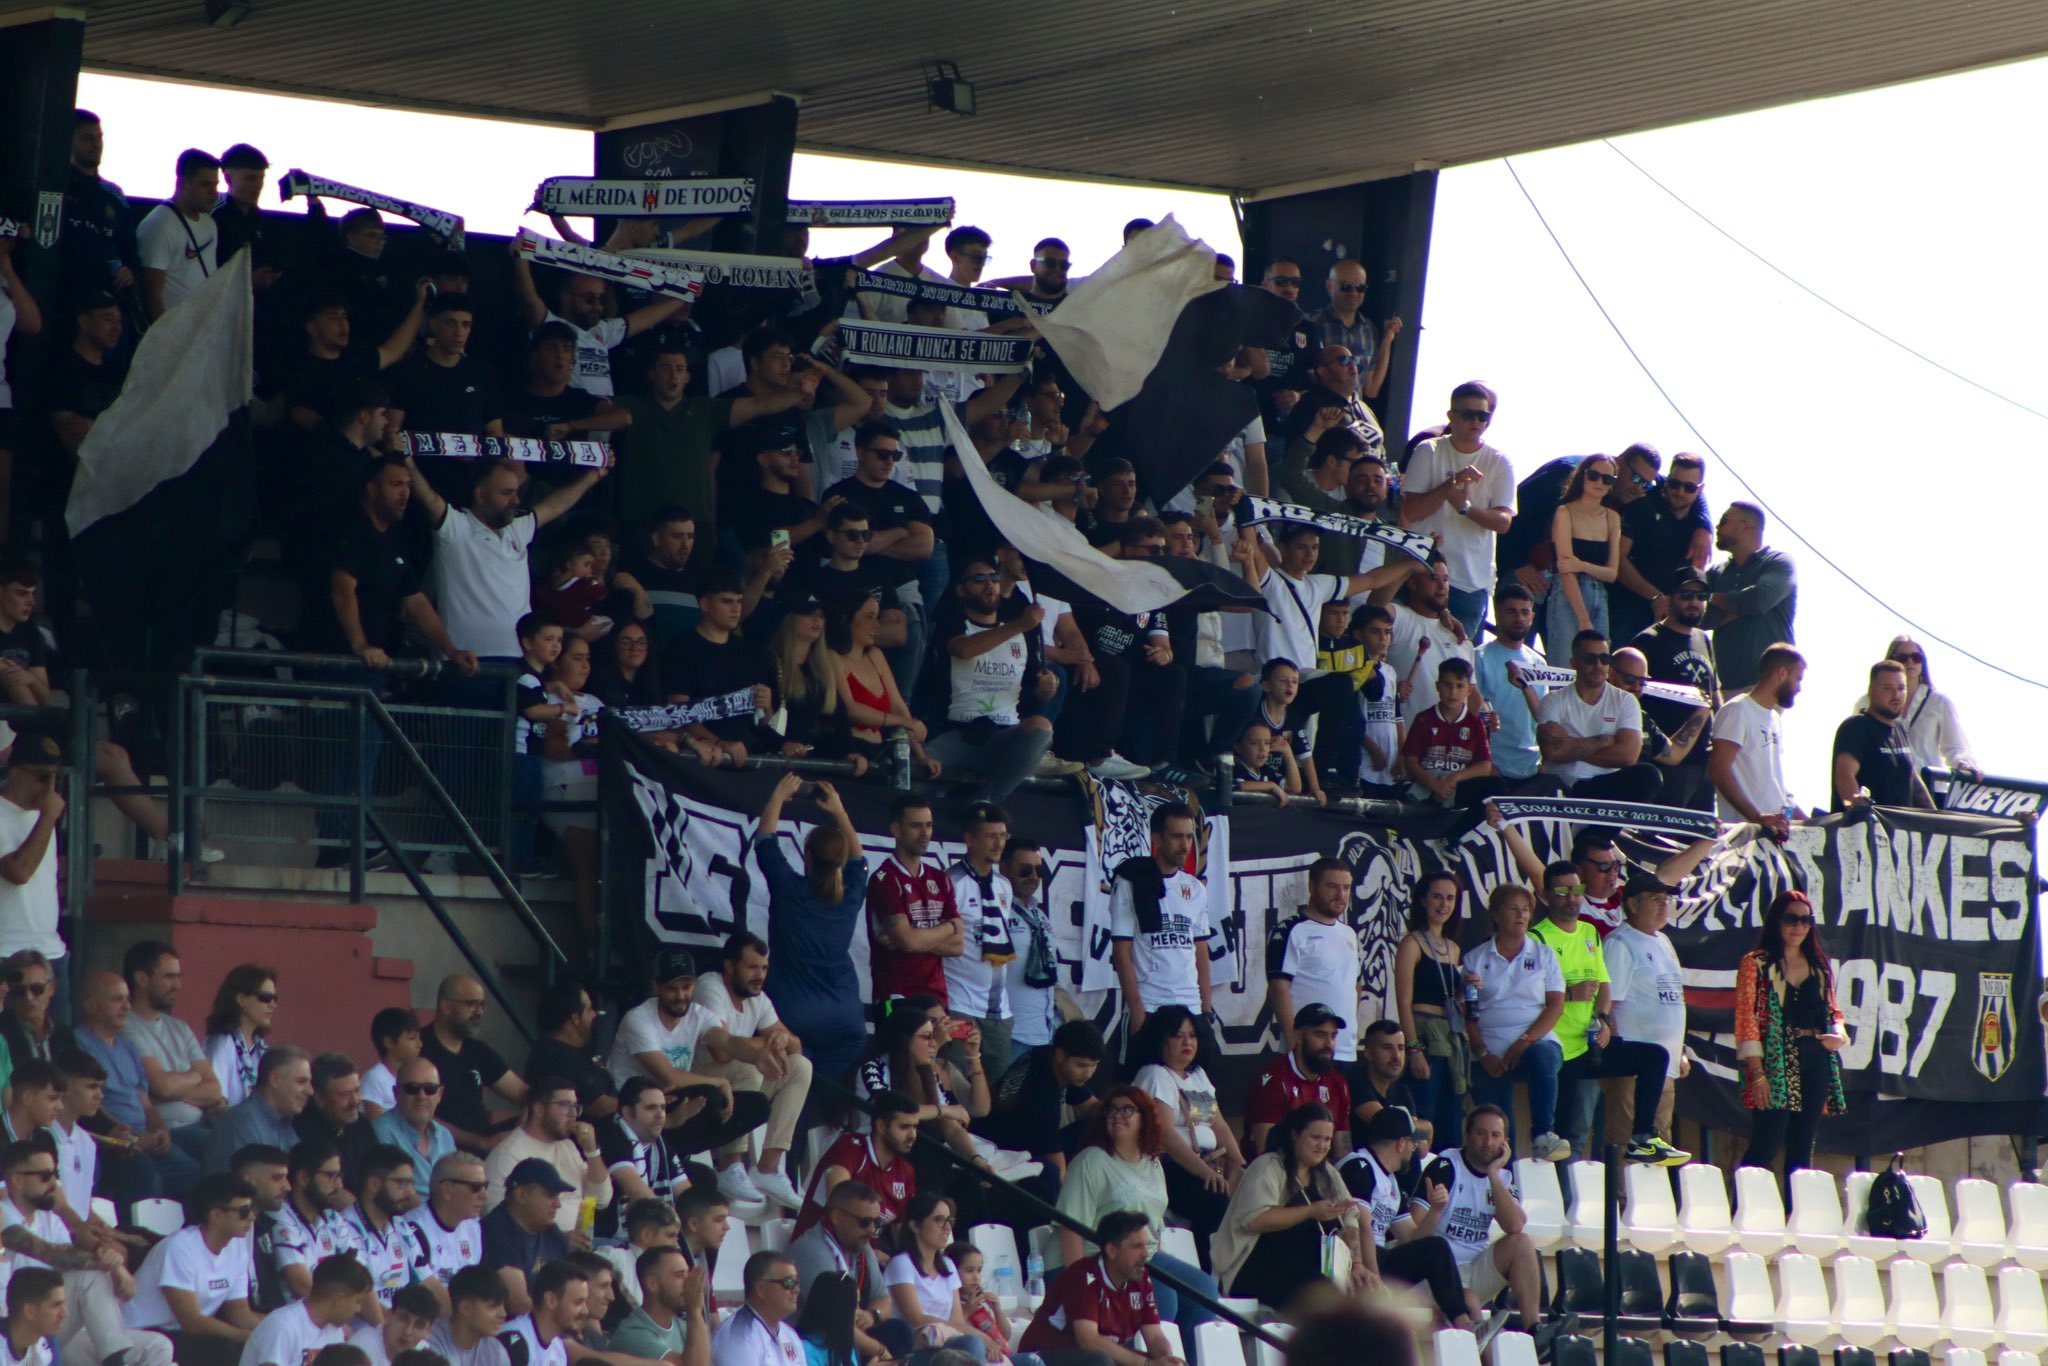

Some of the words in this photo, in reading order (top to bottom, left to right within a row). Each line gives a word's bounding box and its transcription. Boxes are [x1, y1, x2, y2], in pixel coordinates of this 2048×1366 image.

[545, 187, 563, 205] EL
[570, 184, 637, 206] MÉRIDA
[665, 189, 688, 205] DE
[692, 186, 753, 204] TODOS
[730, 266, 803, 288] ROMAN
[861, 331, 913, 356] ROMANO
[916, 337, 955, 359] NUNCA
[960, 340, 975, 360] SE
[979, 341, 1016, 361] RINDE
